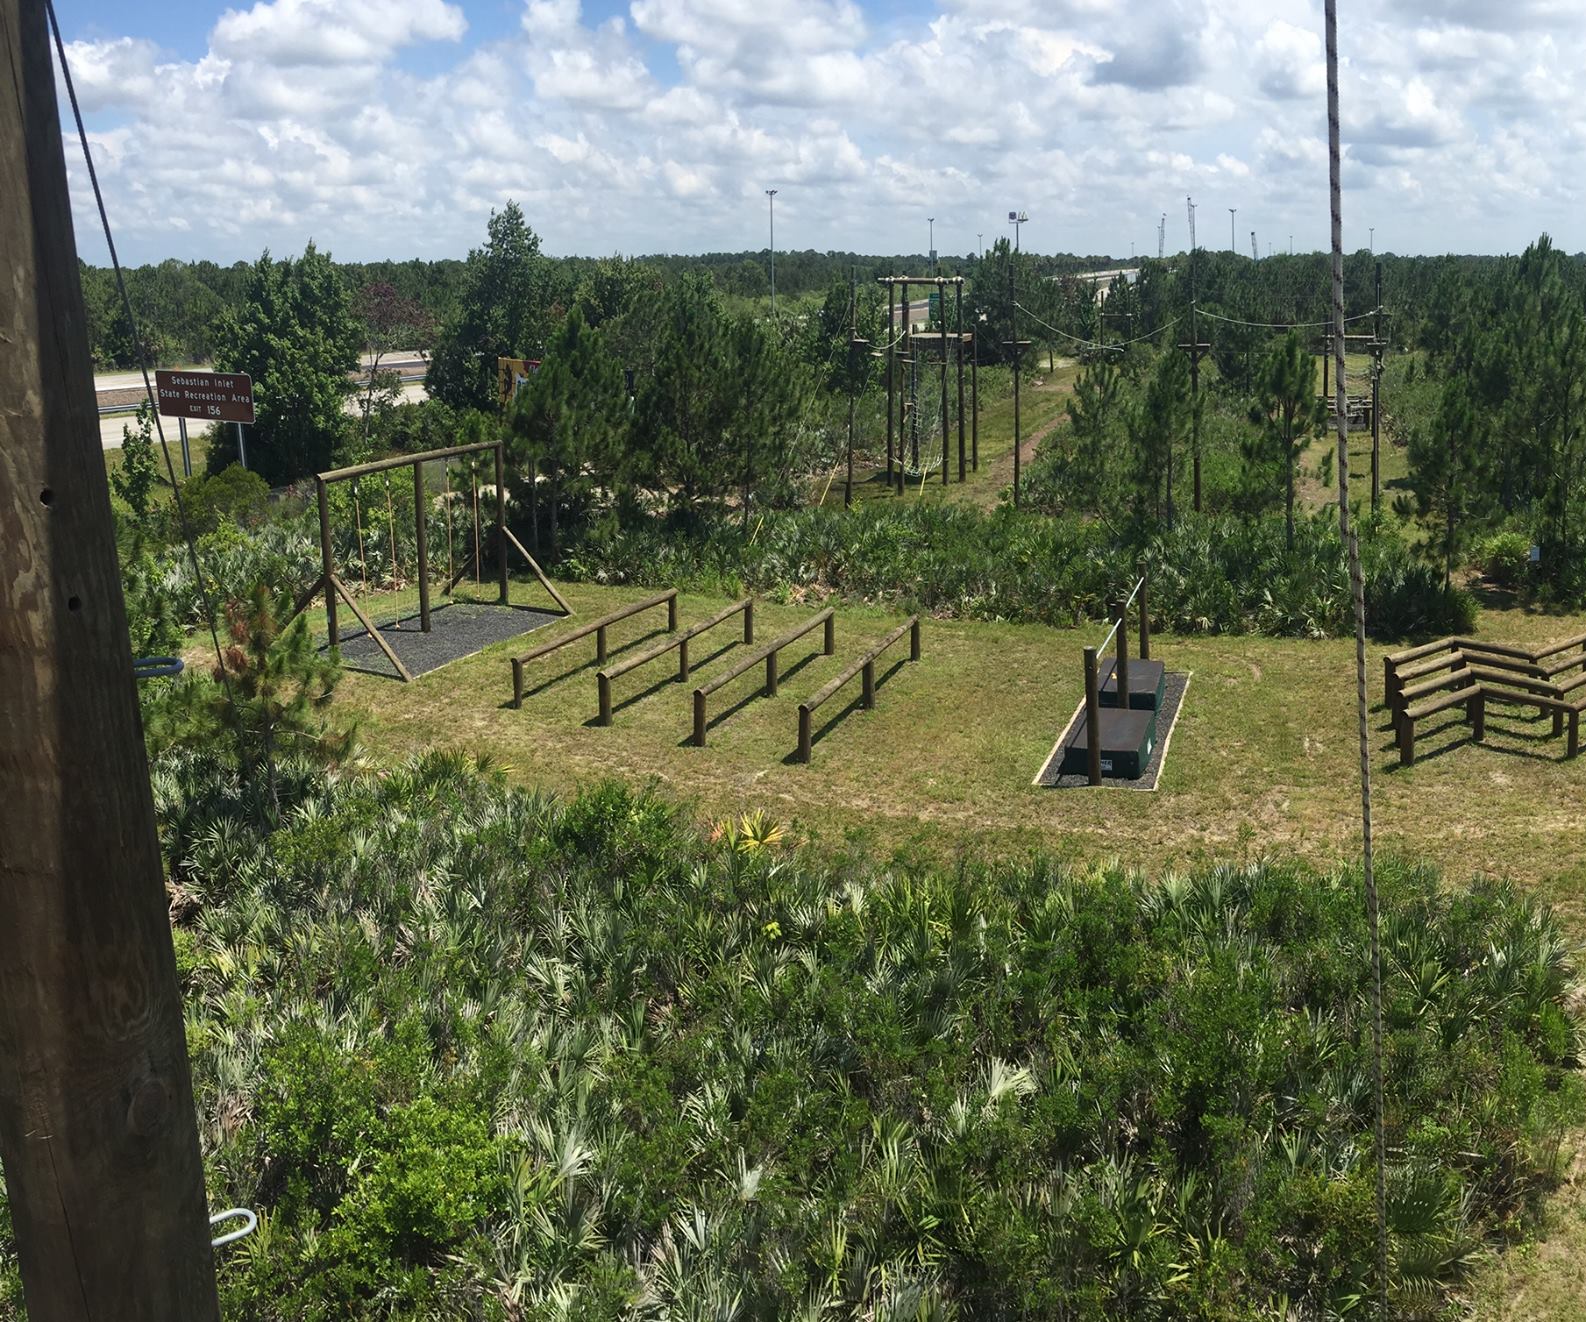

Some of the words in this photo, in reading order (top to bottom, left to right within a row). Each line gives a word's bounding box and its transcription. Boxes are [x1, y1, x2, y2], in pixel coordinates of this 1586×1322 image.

[171, 376, 209, 387] Sebastian
[214, 379, 234, 389] Inlet
[160, 389, 180, 398] State
[185, 390, 226, 401] Recreation
[231, 394, 250, 403] Area
[207, 405, 221, 415] 156
